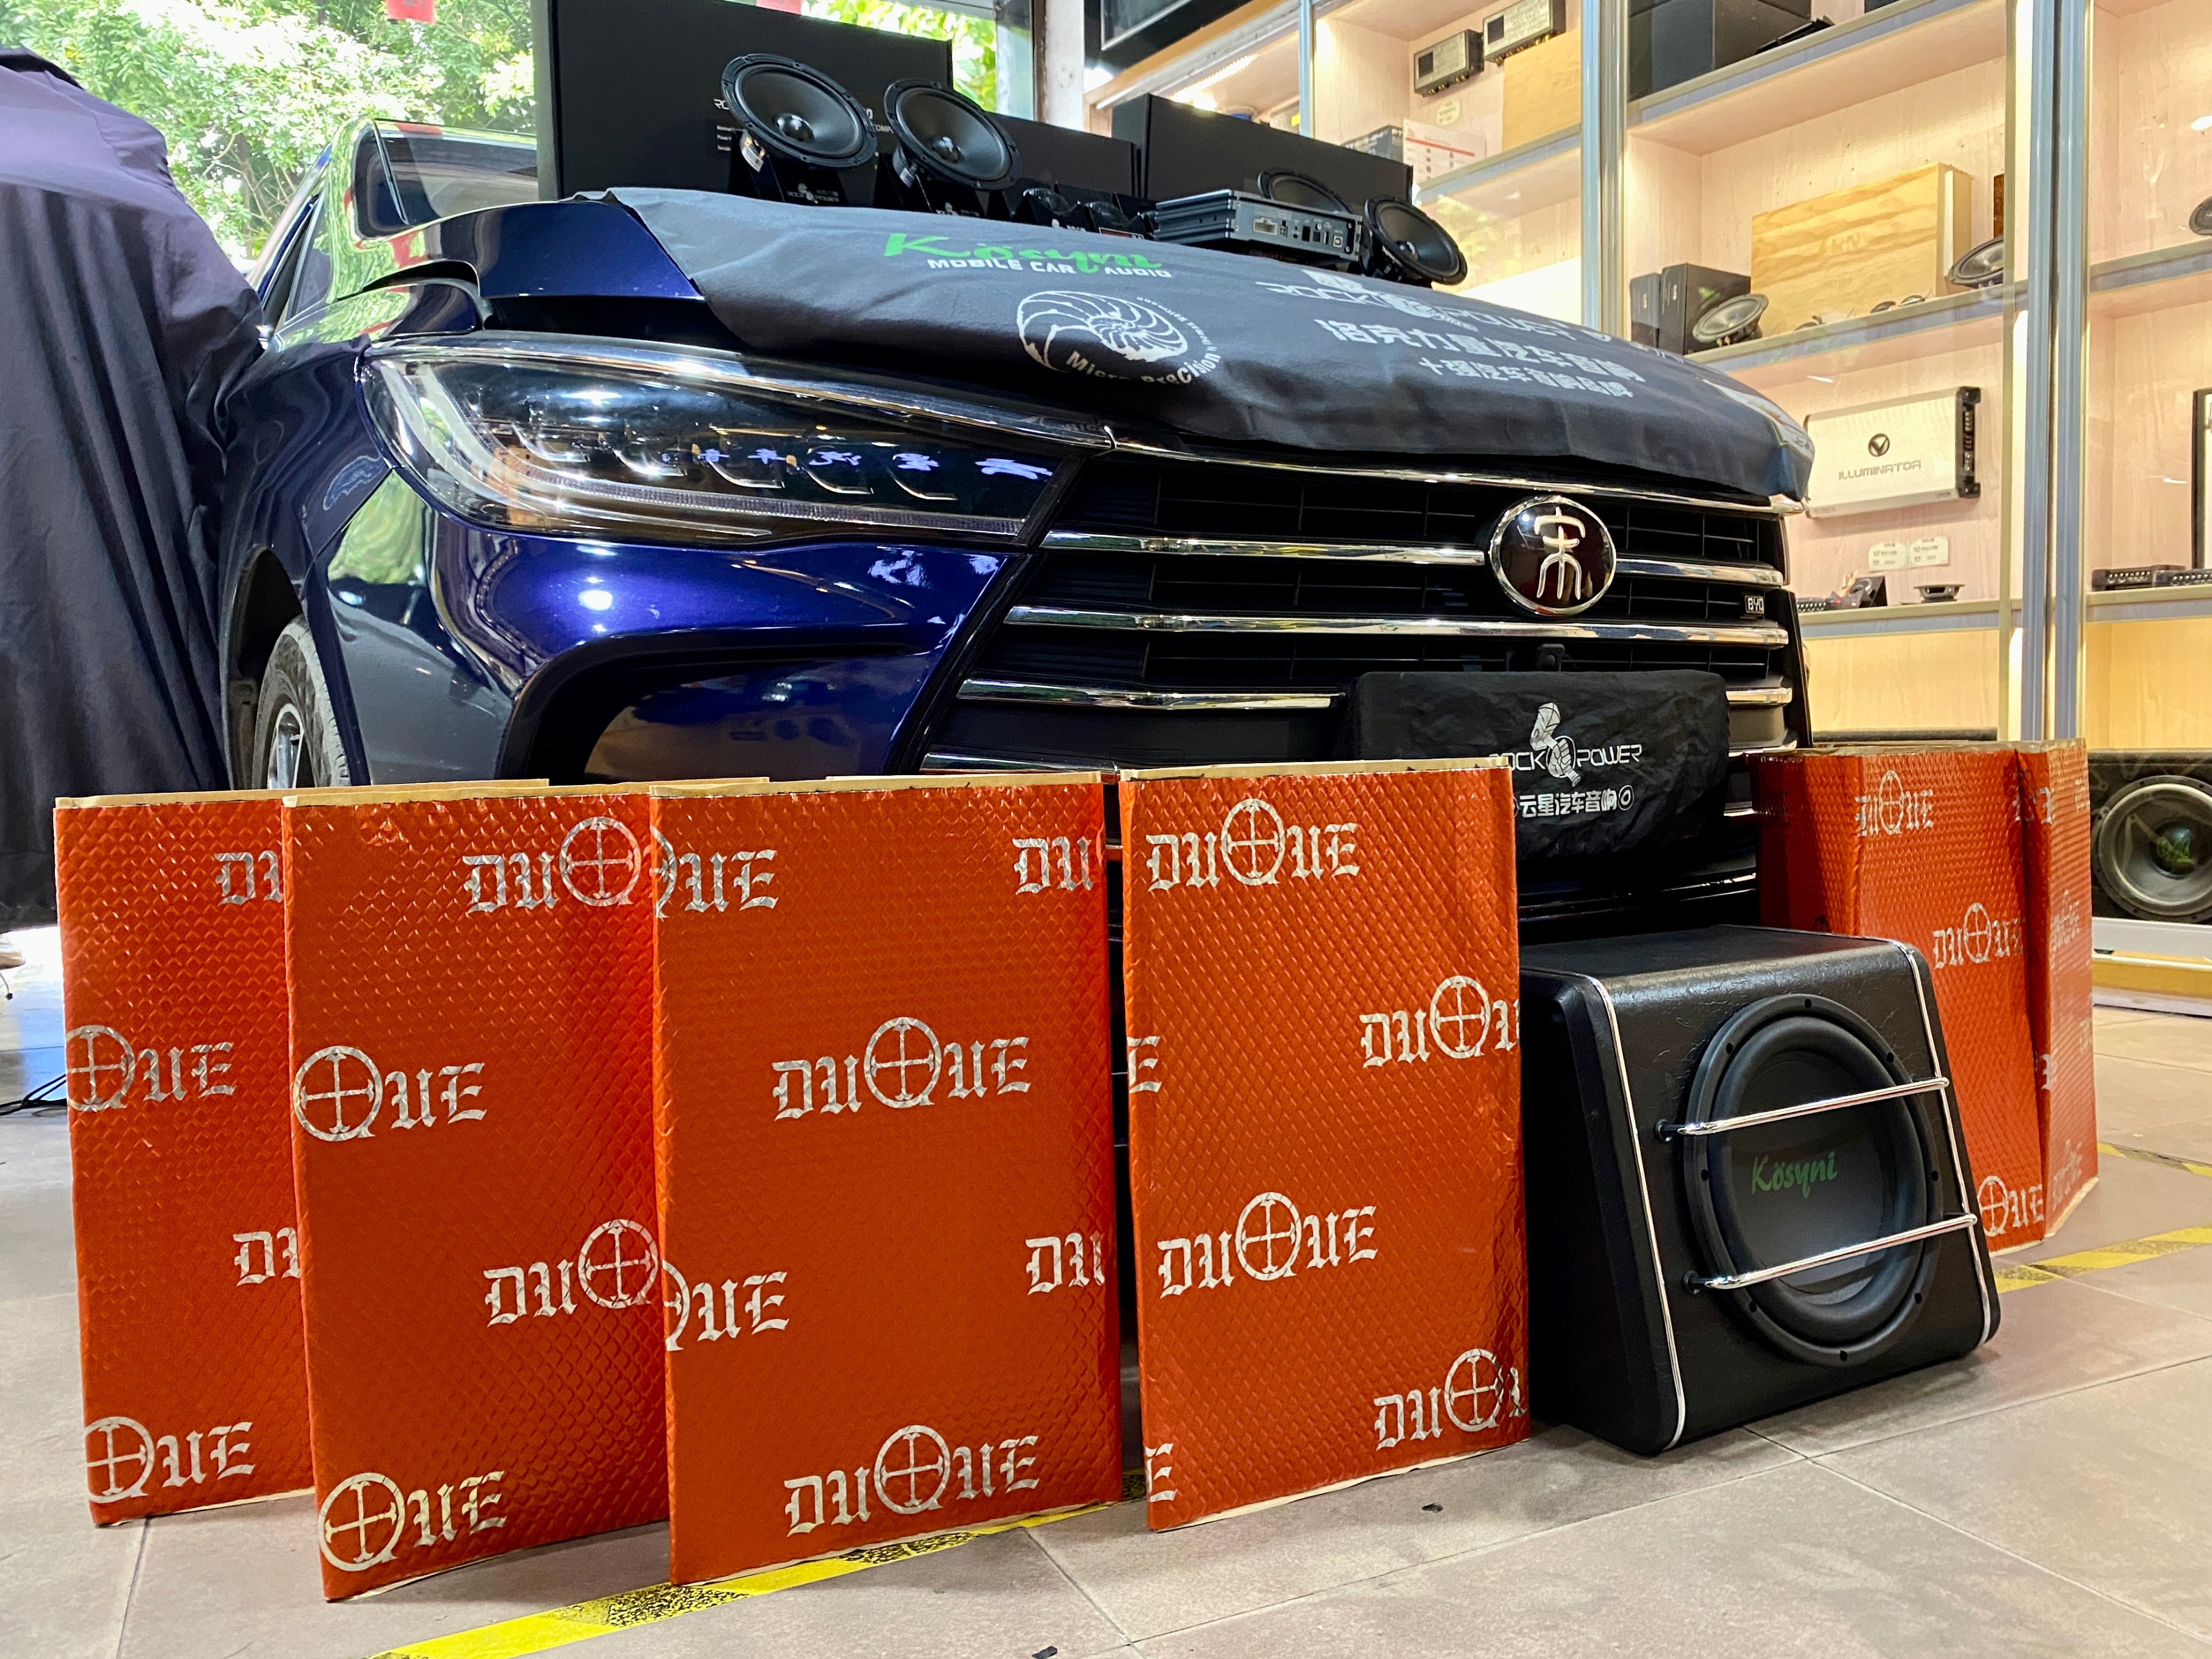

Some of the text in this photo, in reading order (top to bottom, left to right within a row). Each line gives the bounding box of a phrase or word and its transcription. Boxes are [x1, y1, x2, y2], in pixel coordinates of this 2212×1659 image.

[927, 259, 1173, 278] MOBILE CAR AUDIO
[1838, 459, 1922, 481] ILLUMINATOR
[1747, 598, 1764, 612] BYD
[1576, 744, 1642, 768] POWER
[1519, 788, 1617, 819] 云星汽车音响
[463, 816, 651, 914] DUQ
